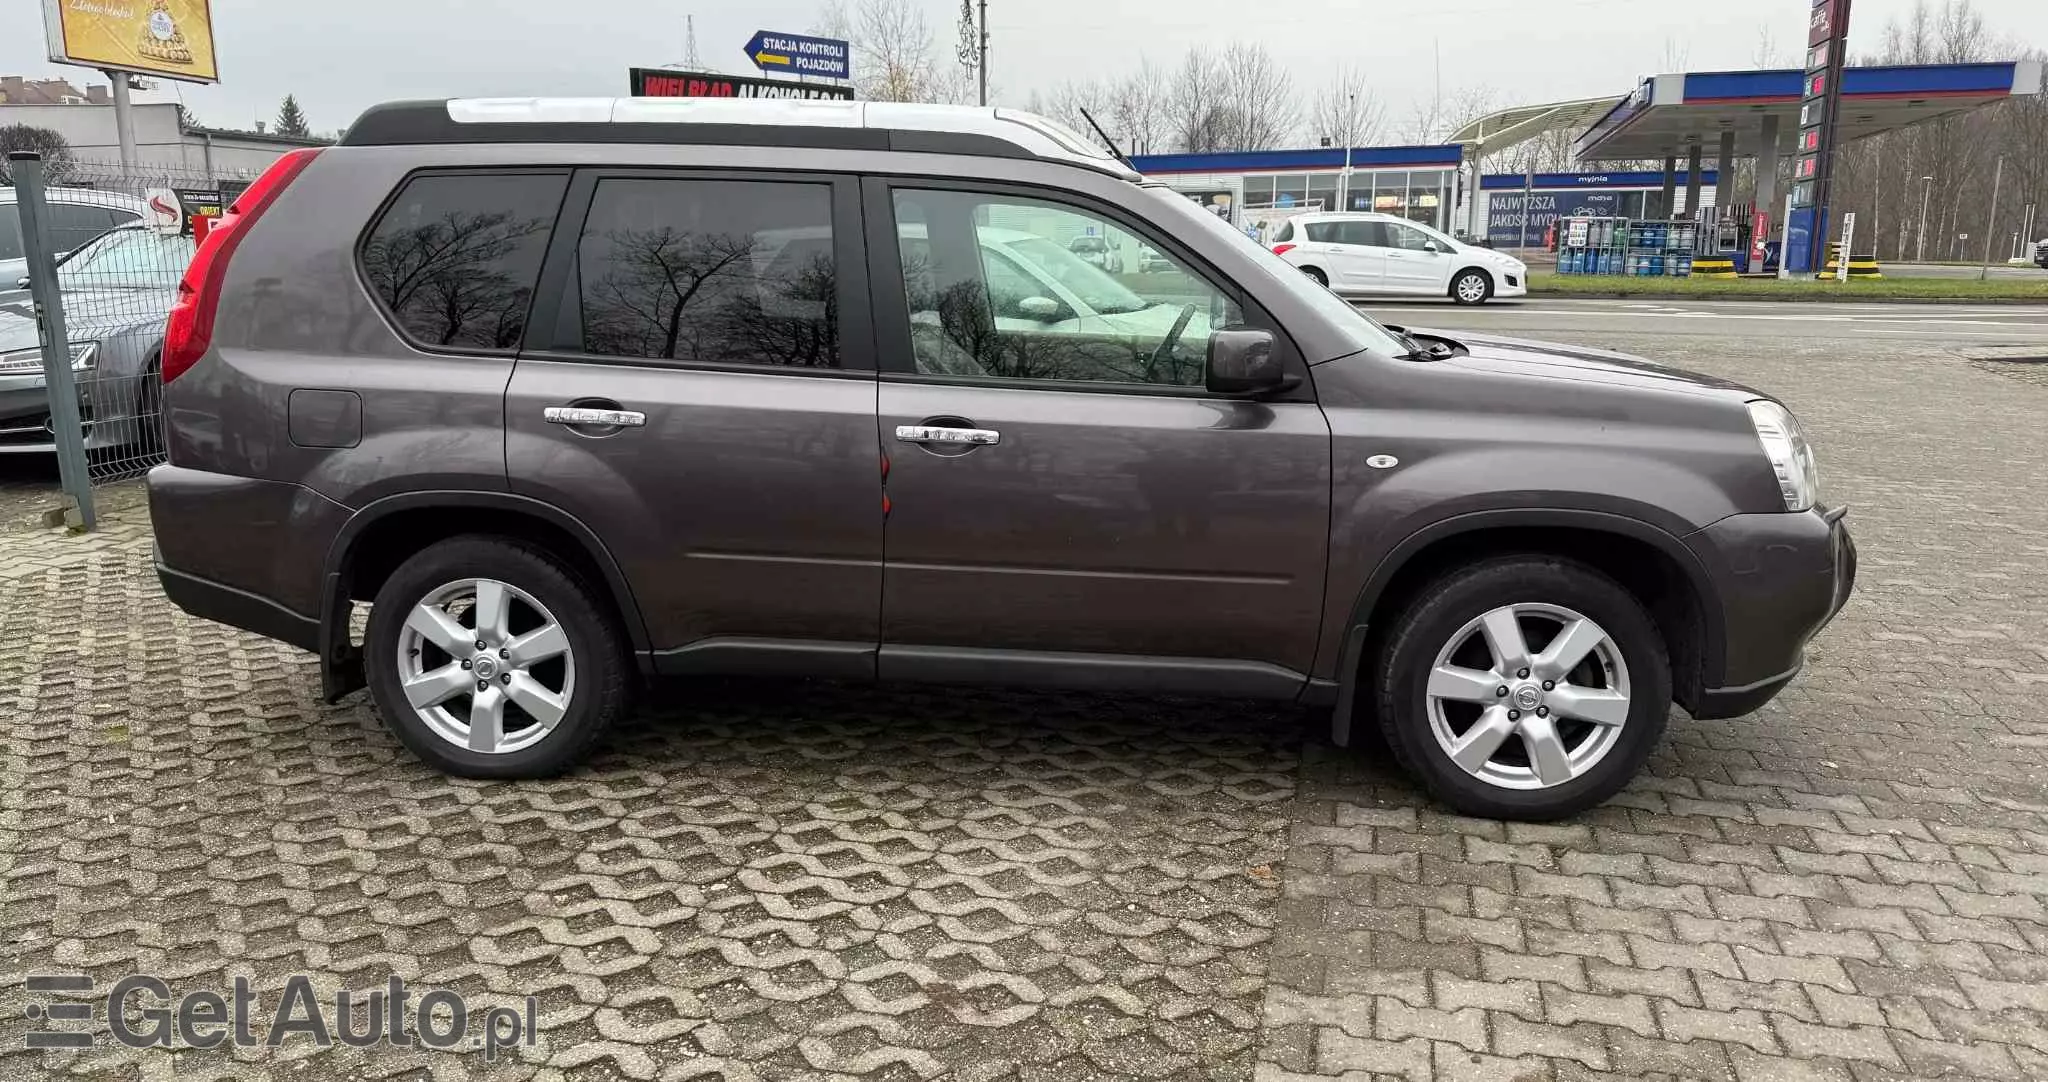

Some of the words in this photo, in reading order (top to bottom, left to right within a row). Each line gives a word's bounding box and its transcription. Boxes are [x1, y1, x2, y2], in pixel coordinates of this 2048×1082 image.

[763, 37, 798, 52] STACJA
[800, 41, 844, 57] KONTROLI
[796, 57, 844, 73] POJAZDÓW
[1578, 175, 1608, 184] myjnia
